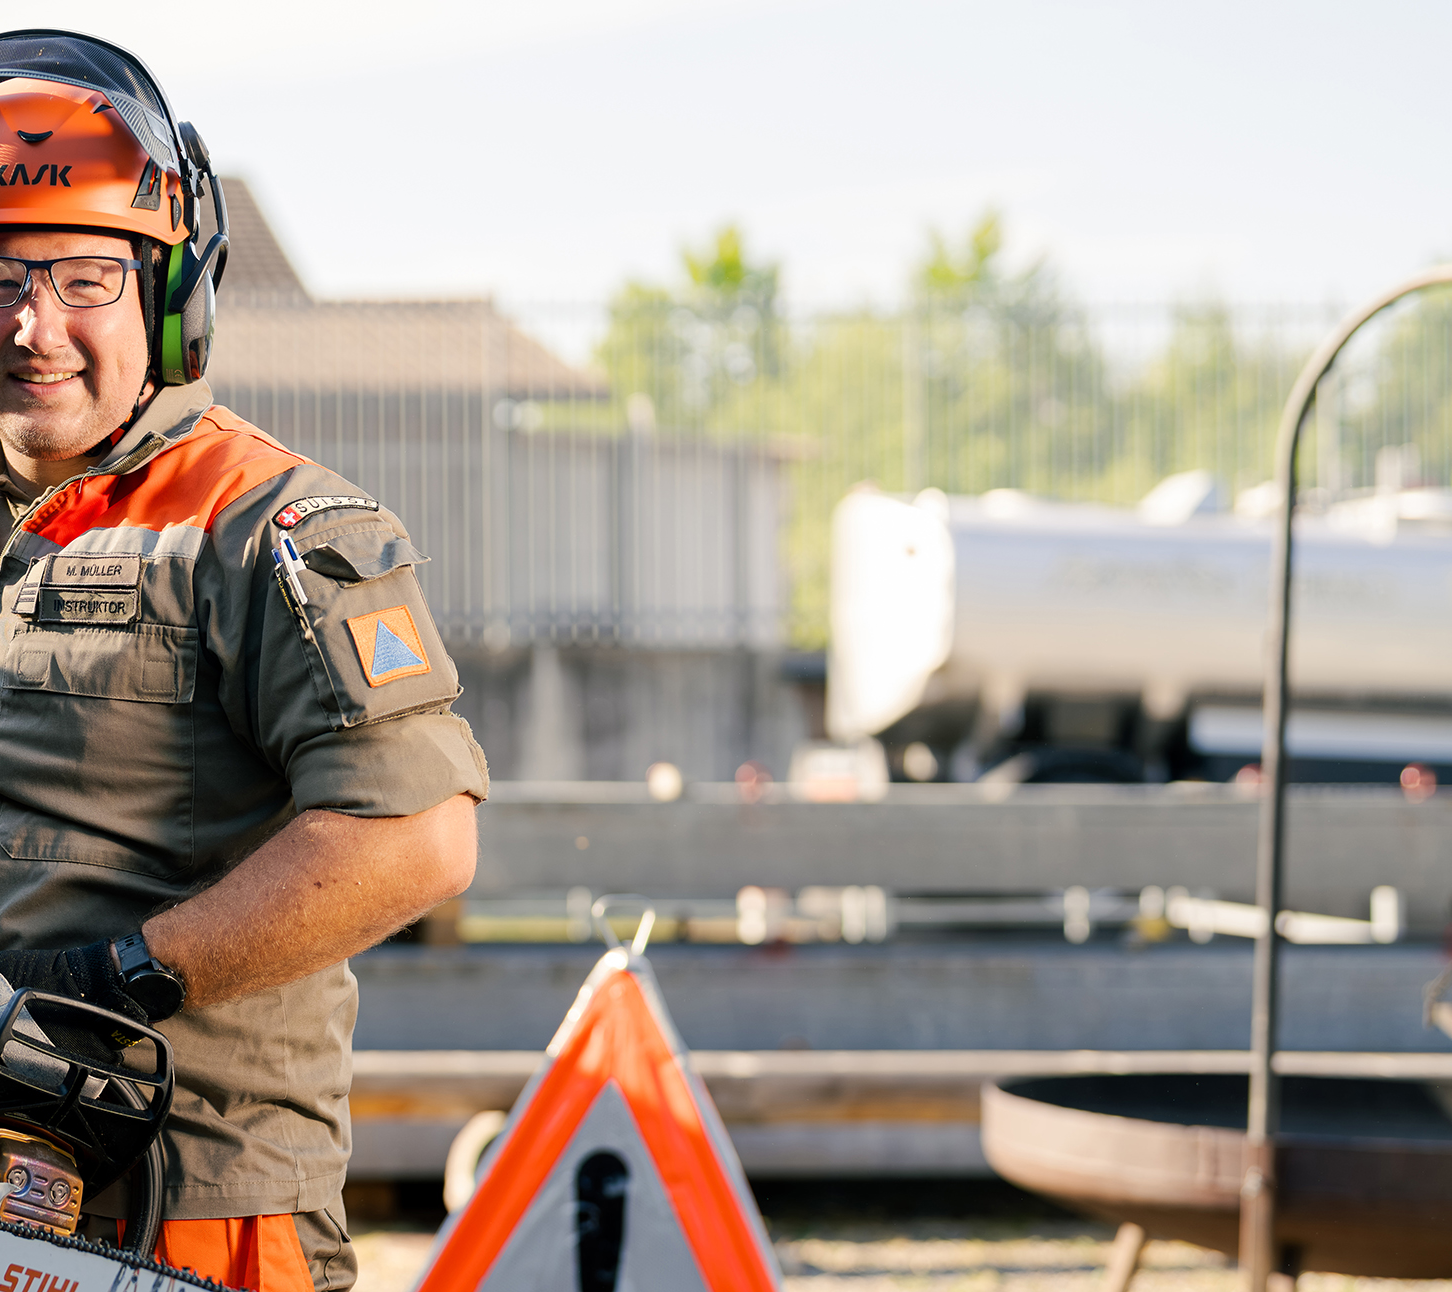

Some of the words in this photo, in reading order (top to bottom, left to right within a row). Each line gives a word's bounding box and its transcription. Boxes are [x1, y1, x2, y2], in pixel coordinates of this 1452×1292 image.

[295, 498, 374, 513] SUISSE
[66, 565, 77, 577] M.
[80, 564, 122, 577] MÜLLER
[53, 600, 127, 615] INSTRUKTOR
